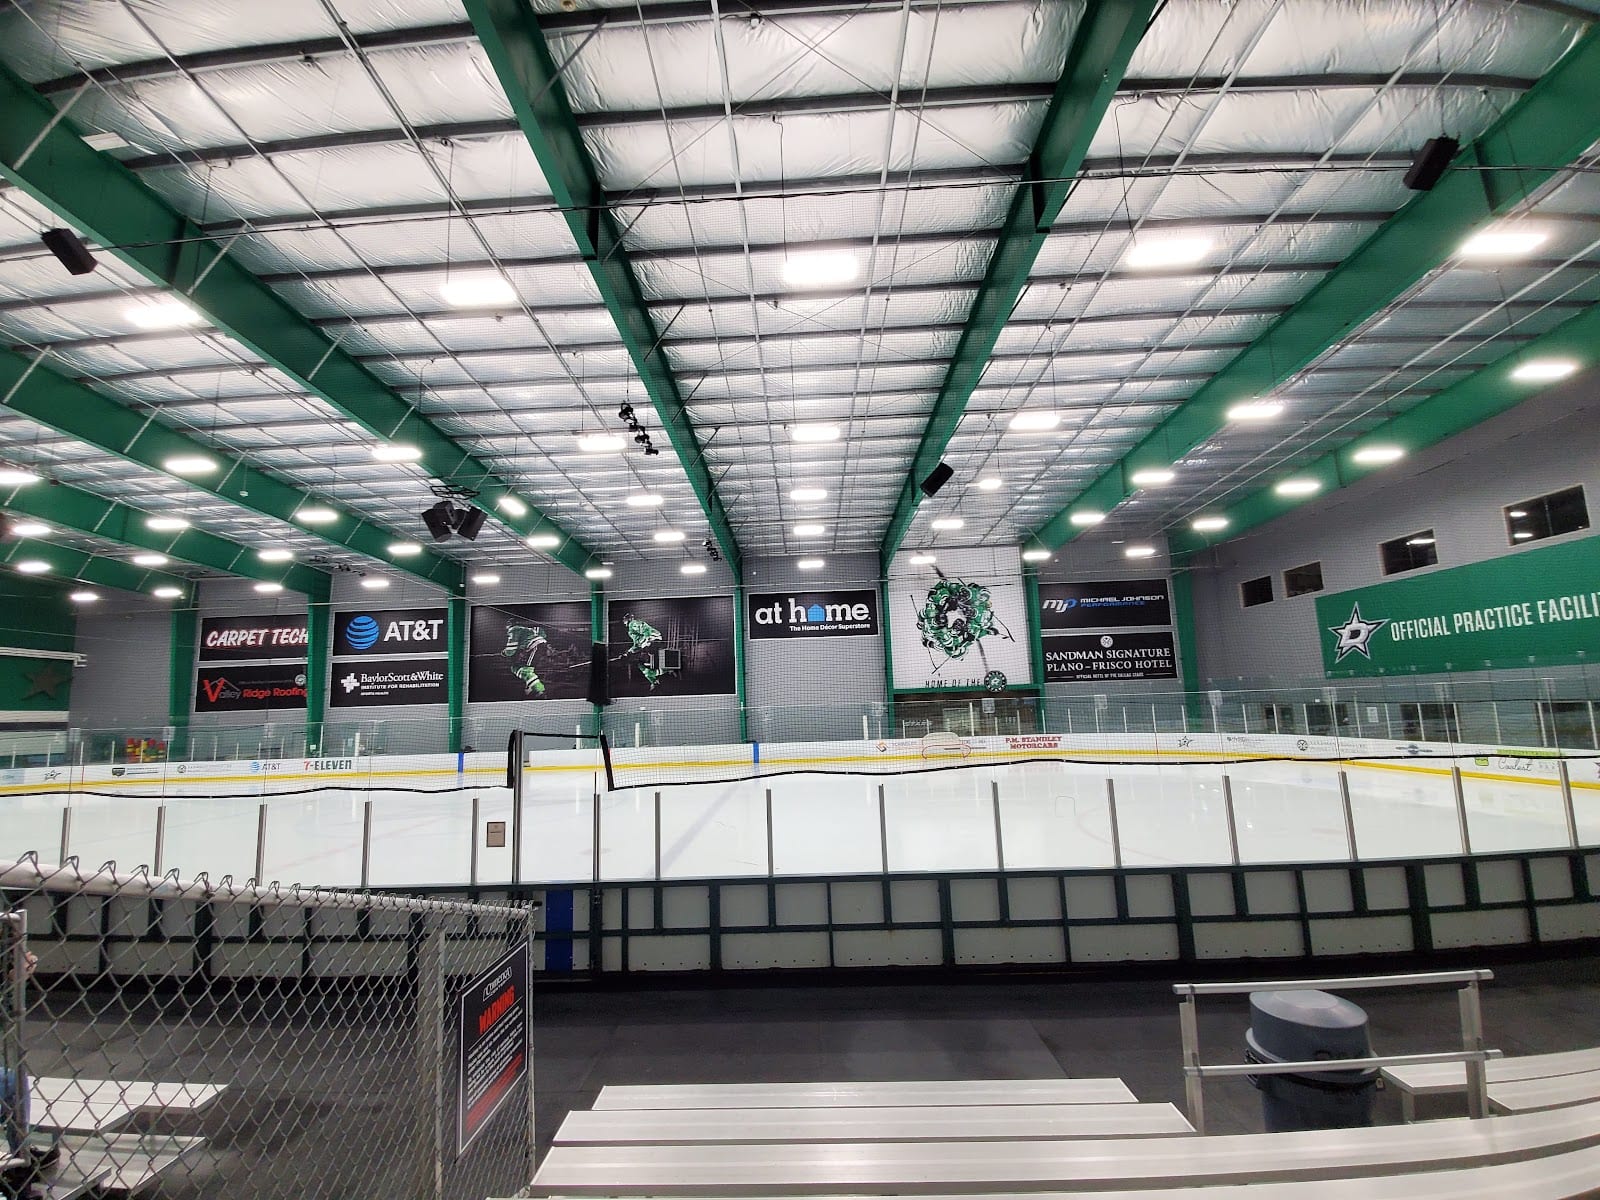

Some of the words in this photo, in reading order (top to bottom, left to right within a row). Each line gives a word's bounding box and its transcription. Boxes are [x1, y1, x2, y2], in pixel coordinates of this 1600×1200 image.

[1119, 595, 1165, 603] JOHNSON
[755, 602, 782, 624] at
[1391, 615, 1450, 642] OFFICIAL
[1453, 602, 1533, 634] PRACTICE
[1537, 592, 1600, 624] FACILI
[383, 619, 444, 641] AT&T
[820, 623, 837, 631] Décor
[206, 629, 269, 647] CARPET
[271, 628, 309, 645] TECH
[1046, 650, 1103, 661] SANDMAN
[1106, 648, 1171, 659] SIGNATURE
[1135, 659, 1172, 669] HOTEL
[243, 688, 271, 699] Ridge
[262, 763, 281, 771] AT&T
[479, 985, 515, 1035] WARNING
